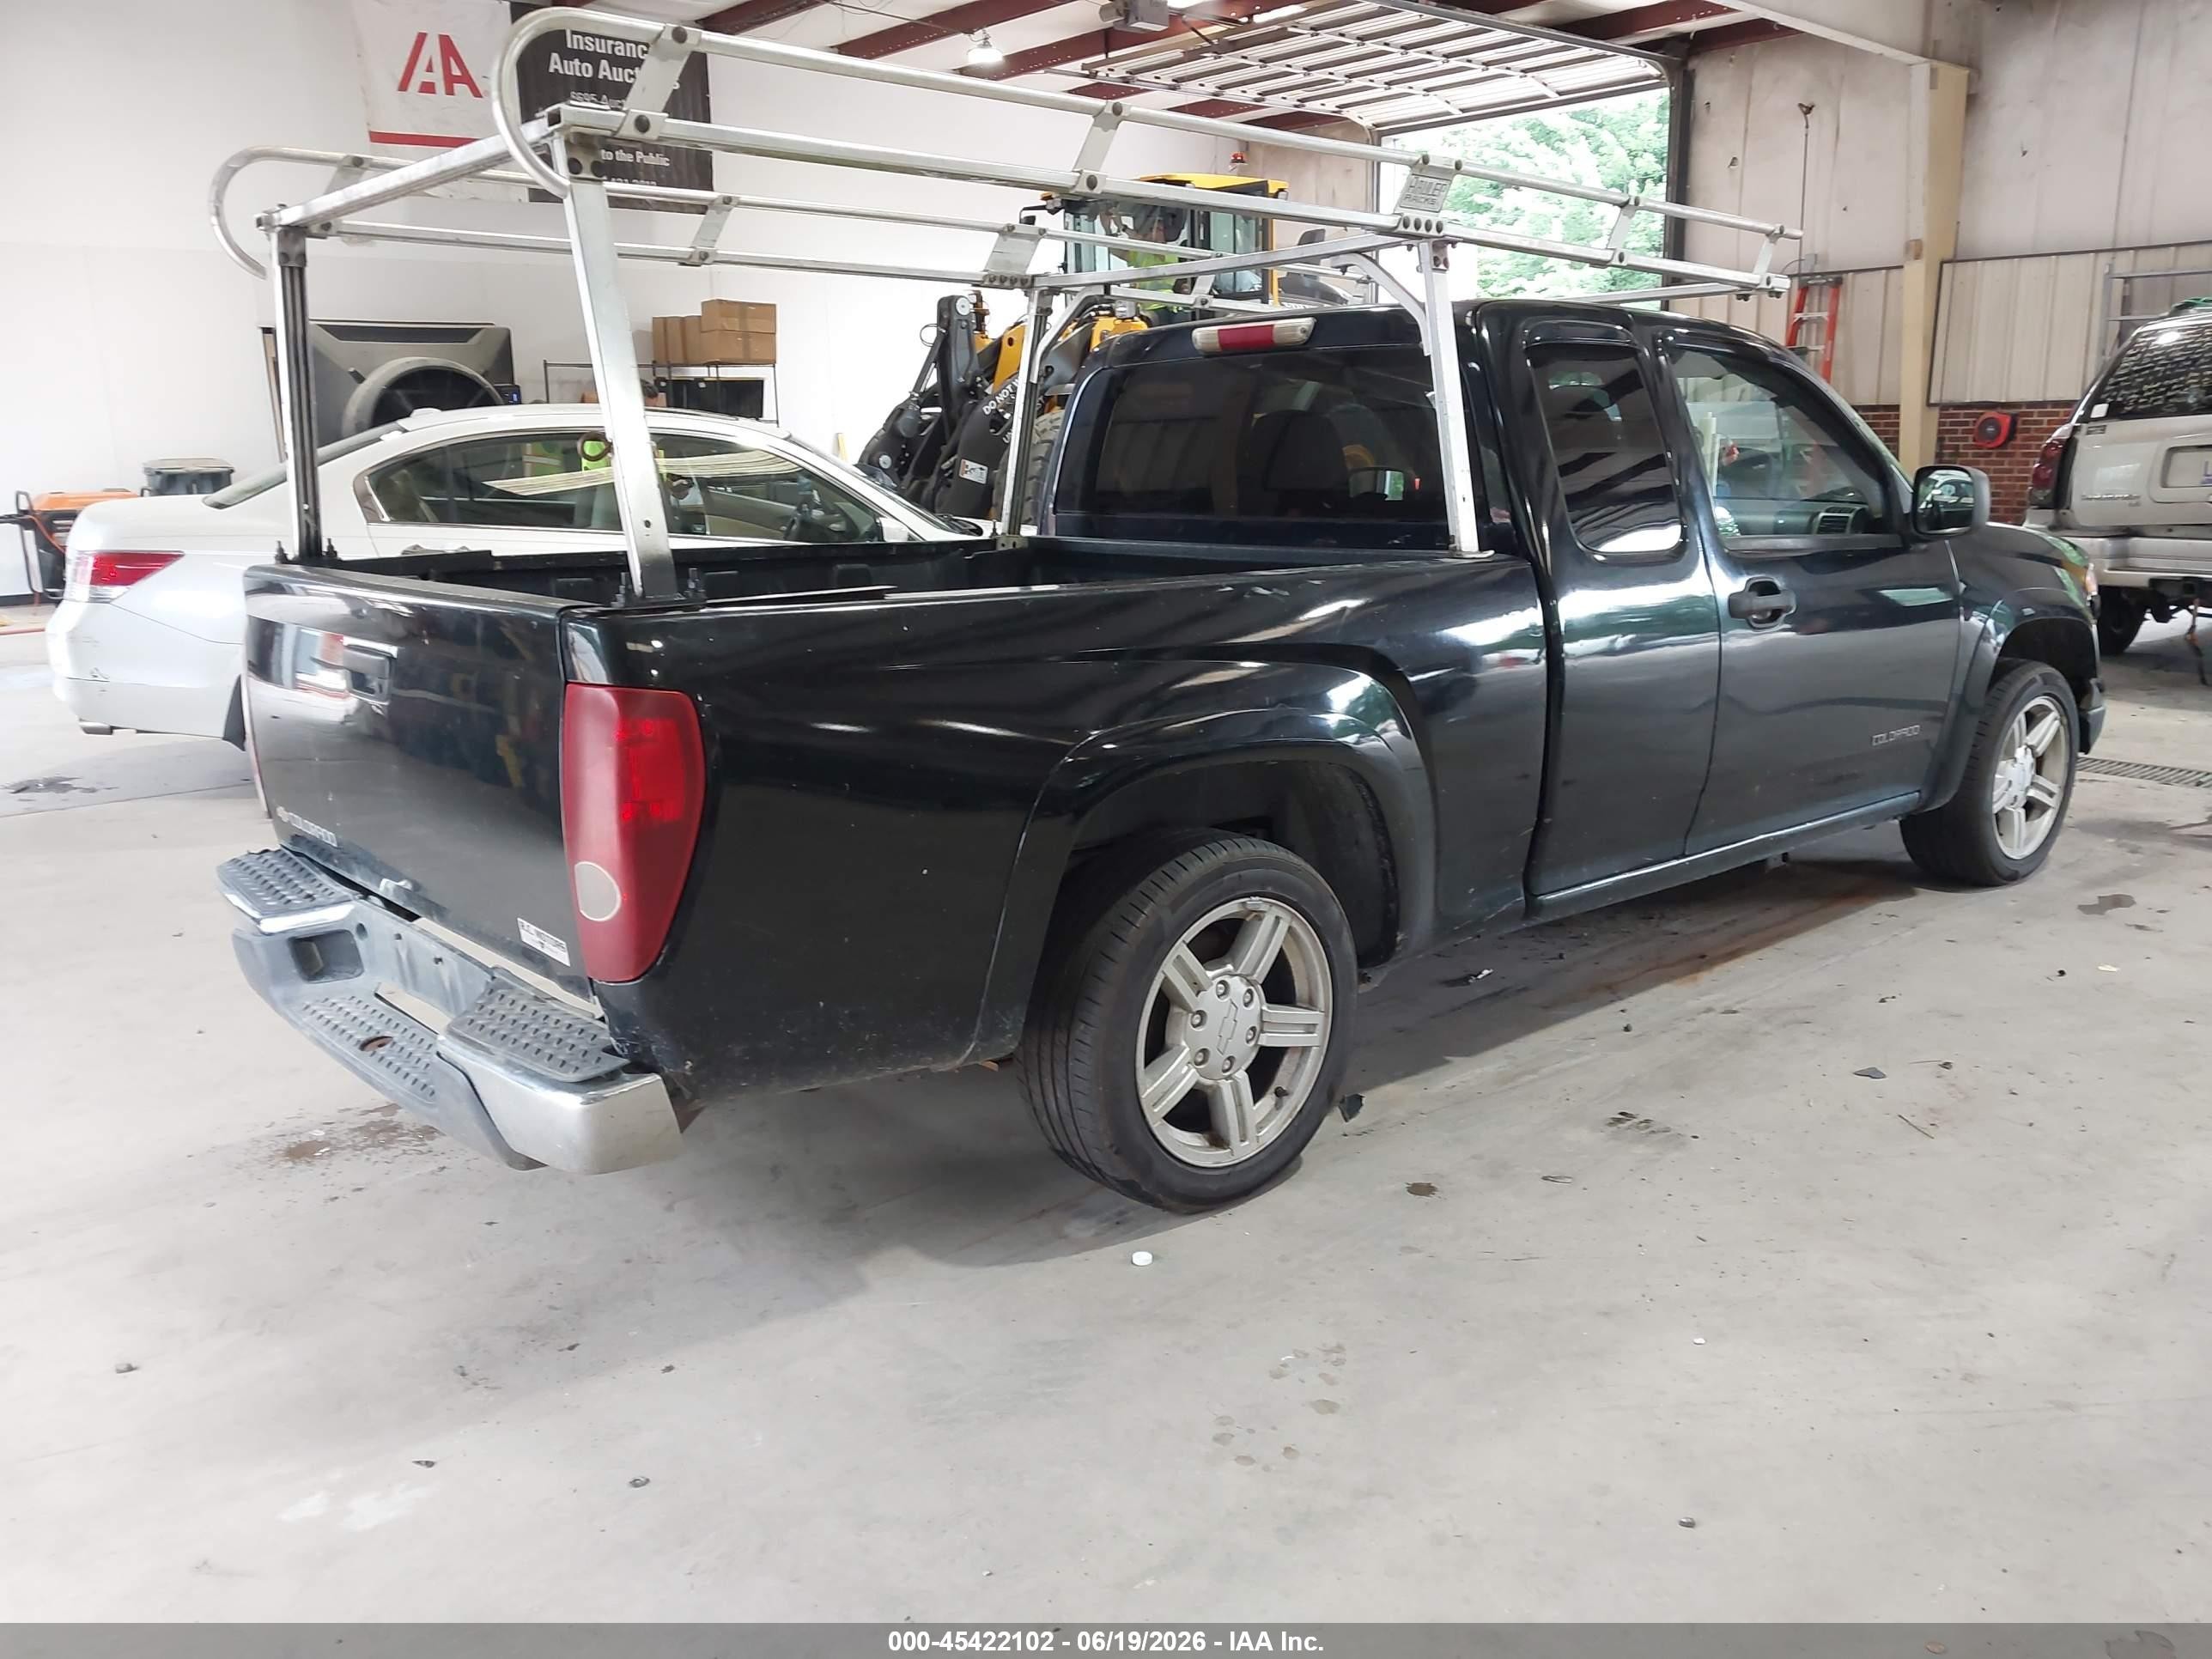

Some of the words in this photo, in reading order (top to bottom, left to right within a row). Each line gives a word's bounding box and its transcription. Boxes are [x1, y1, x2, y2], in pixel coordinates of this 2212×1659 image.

[565, 28, 648, 59] Insuranc
[549, 52, 593, 78] Auto
[601, 149, 614, 161] to
[615, 149, 635, 162] the
[635, 150, 670, 167] Public
[982, 400, 997, 415] DO
[995, 383, 1017, 404] NOT
